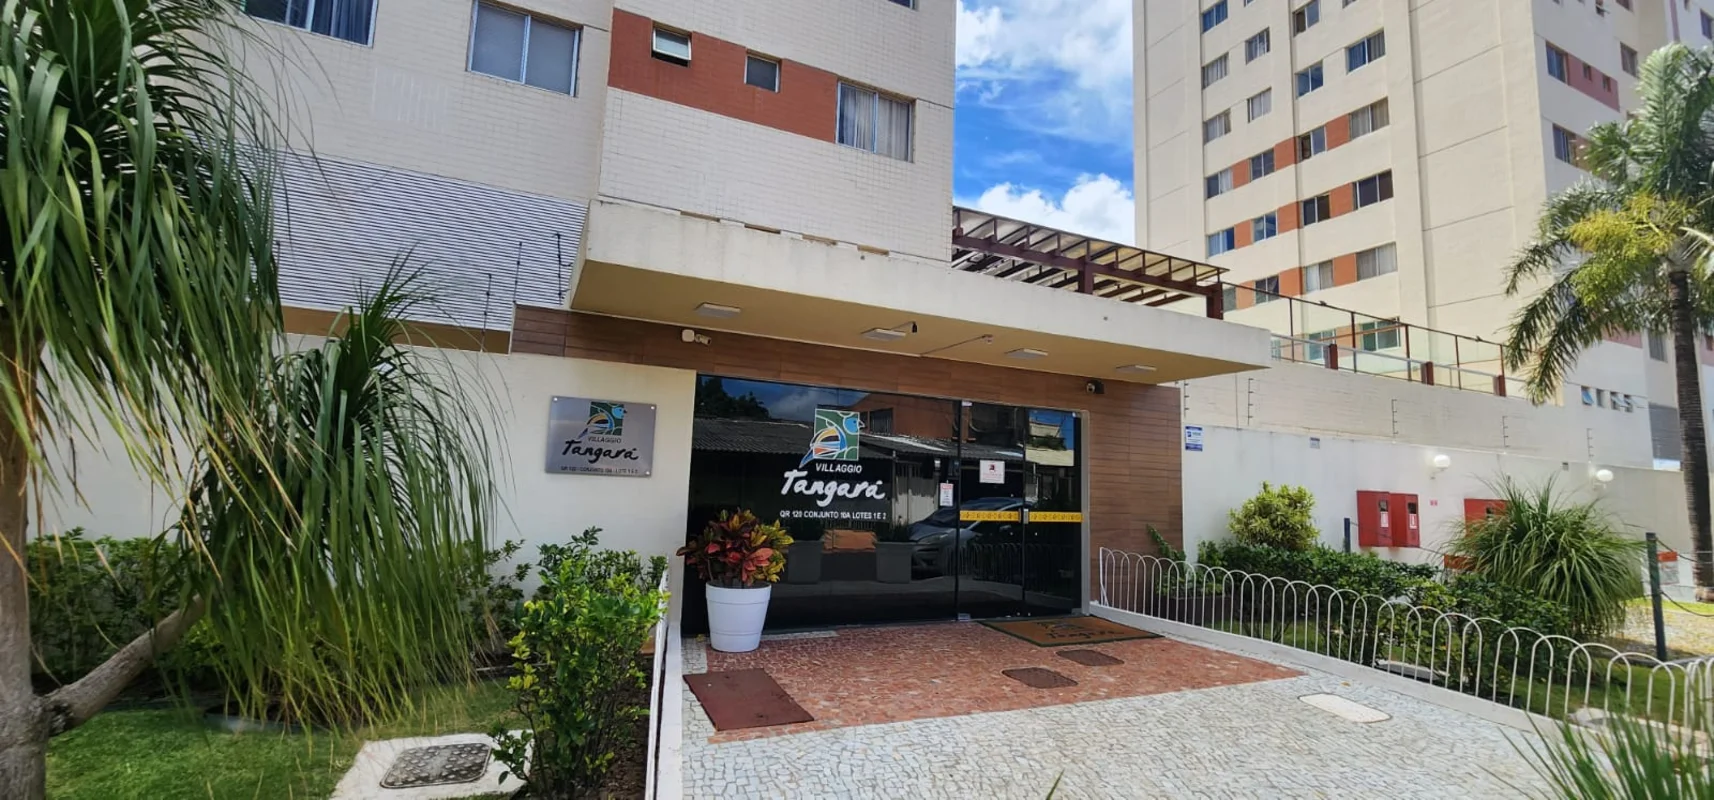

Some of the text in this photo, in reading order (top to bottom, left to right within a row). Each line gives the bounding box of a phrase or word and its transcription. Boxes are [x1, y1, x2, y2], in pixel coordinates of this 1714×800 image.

[562, 440, 639, 463] Tangará
[815, 463, 863, 473] VILLAGGIO
[781, 469, 885, 507] Tangará
[780, 510, 790, 518] QR
[804, 510, 839, 519] CONJUNTO
[852, 511, 872, 519] LOTES
